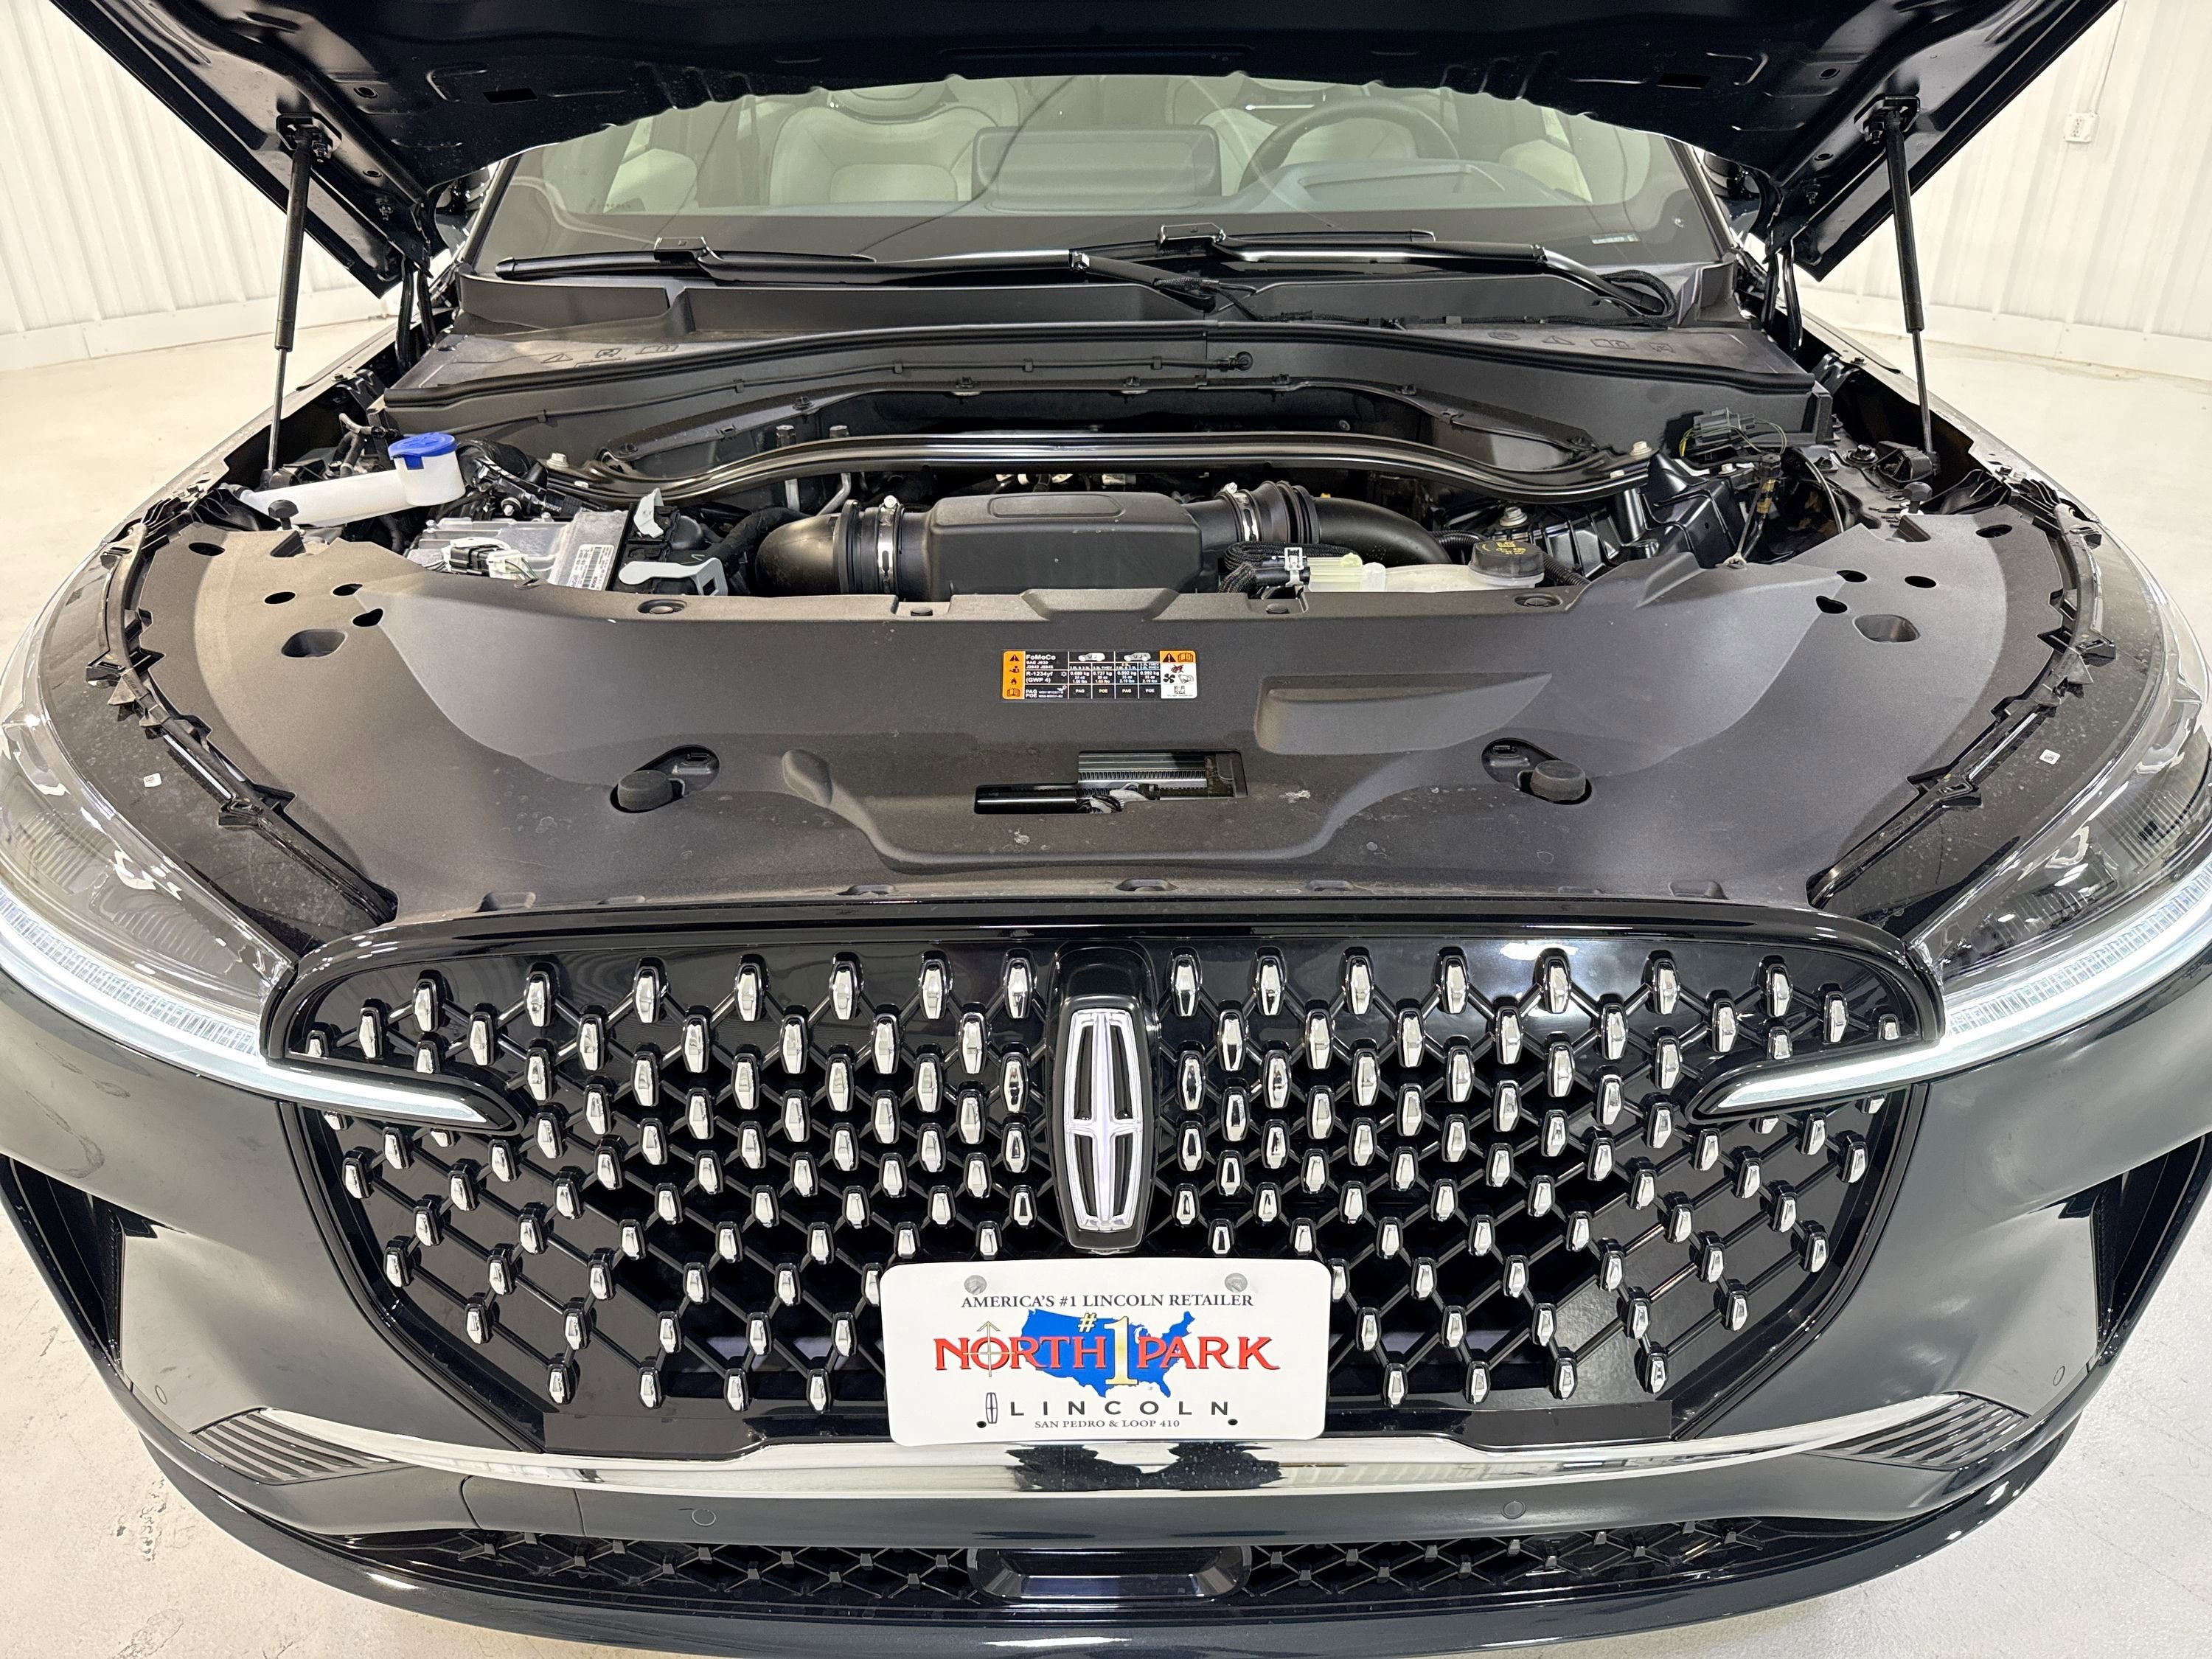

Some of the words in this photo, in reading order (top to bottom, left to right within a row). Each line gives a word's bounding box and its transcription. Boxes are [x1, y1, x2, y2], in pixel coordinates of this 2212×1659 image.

[961, 1294, 1054, 1308] AMERICA'S
[1059, 1295, 1077, 1307] #1
[1082, 1294, 1164, 1307] LINCOLN
[1169, 1294, 1254, 1307] RETAILER
[934, 1336, 1106, 1370] NORTH
[1137, 1336, 1281, 1370] PARK
[1010, 1400, 1229, 1417] LINCOLN
